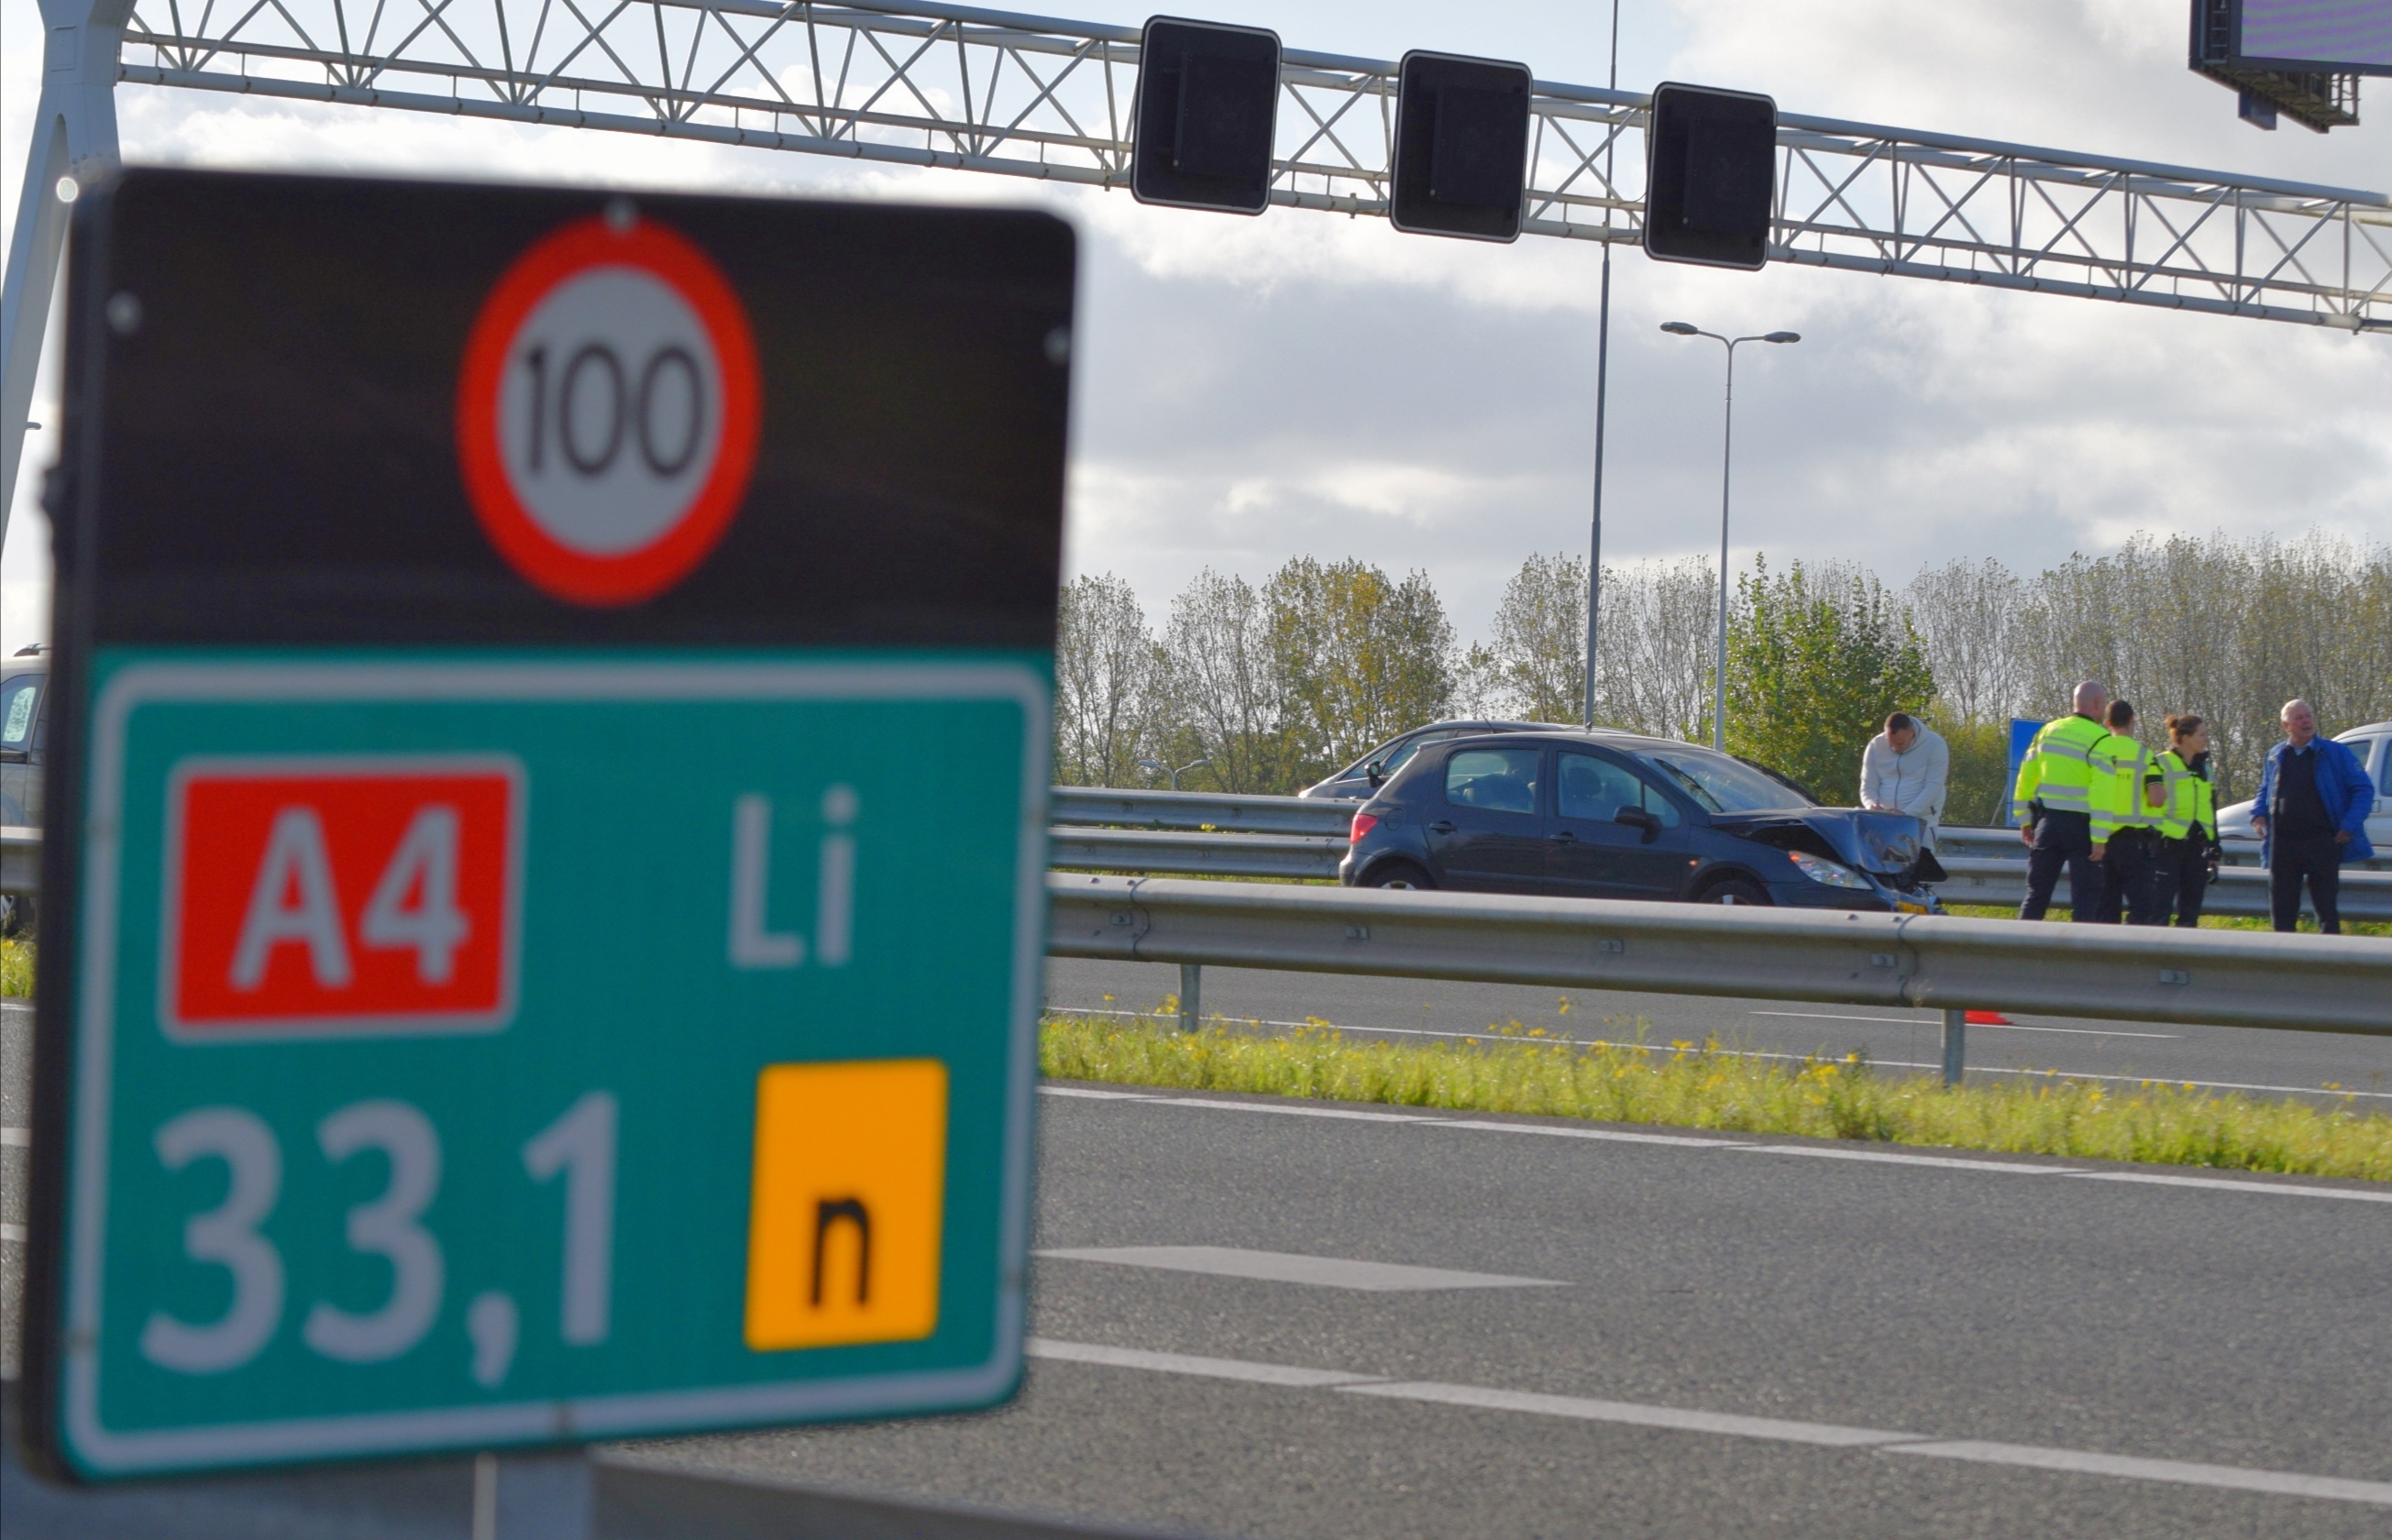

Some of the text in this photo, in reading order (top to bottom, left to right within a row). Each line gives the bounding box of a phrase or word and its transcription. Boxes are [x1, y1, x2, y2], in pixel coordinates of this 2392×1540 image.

[523, 339, 703, 480] 100
[226, 805, 471, 991] A4
[730, 785, 858, 968] Li
[139, 1091, 620, 1389] 33,1
[807, 1194, 874, 1310] n
